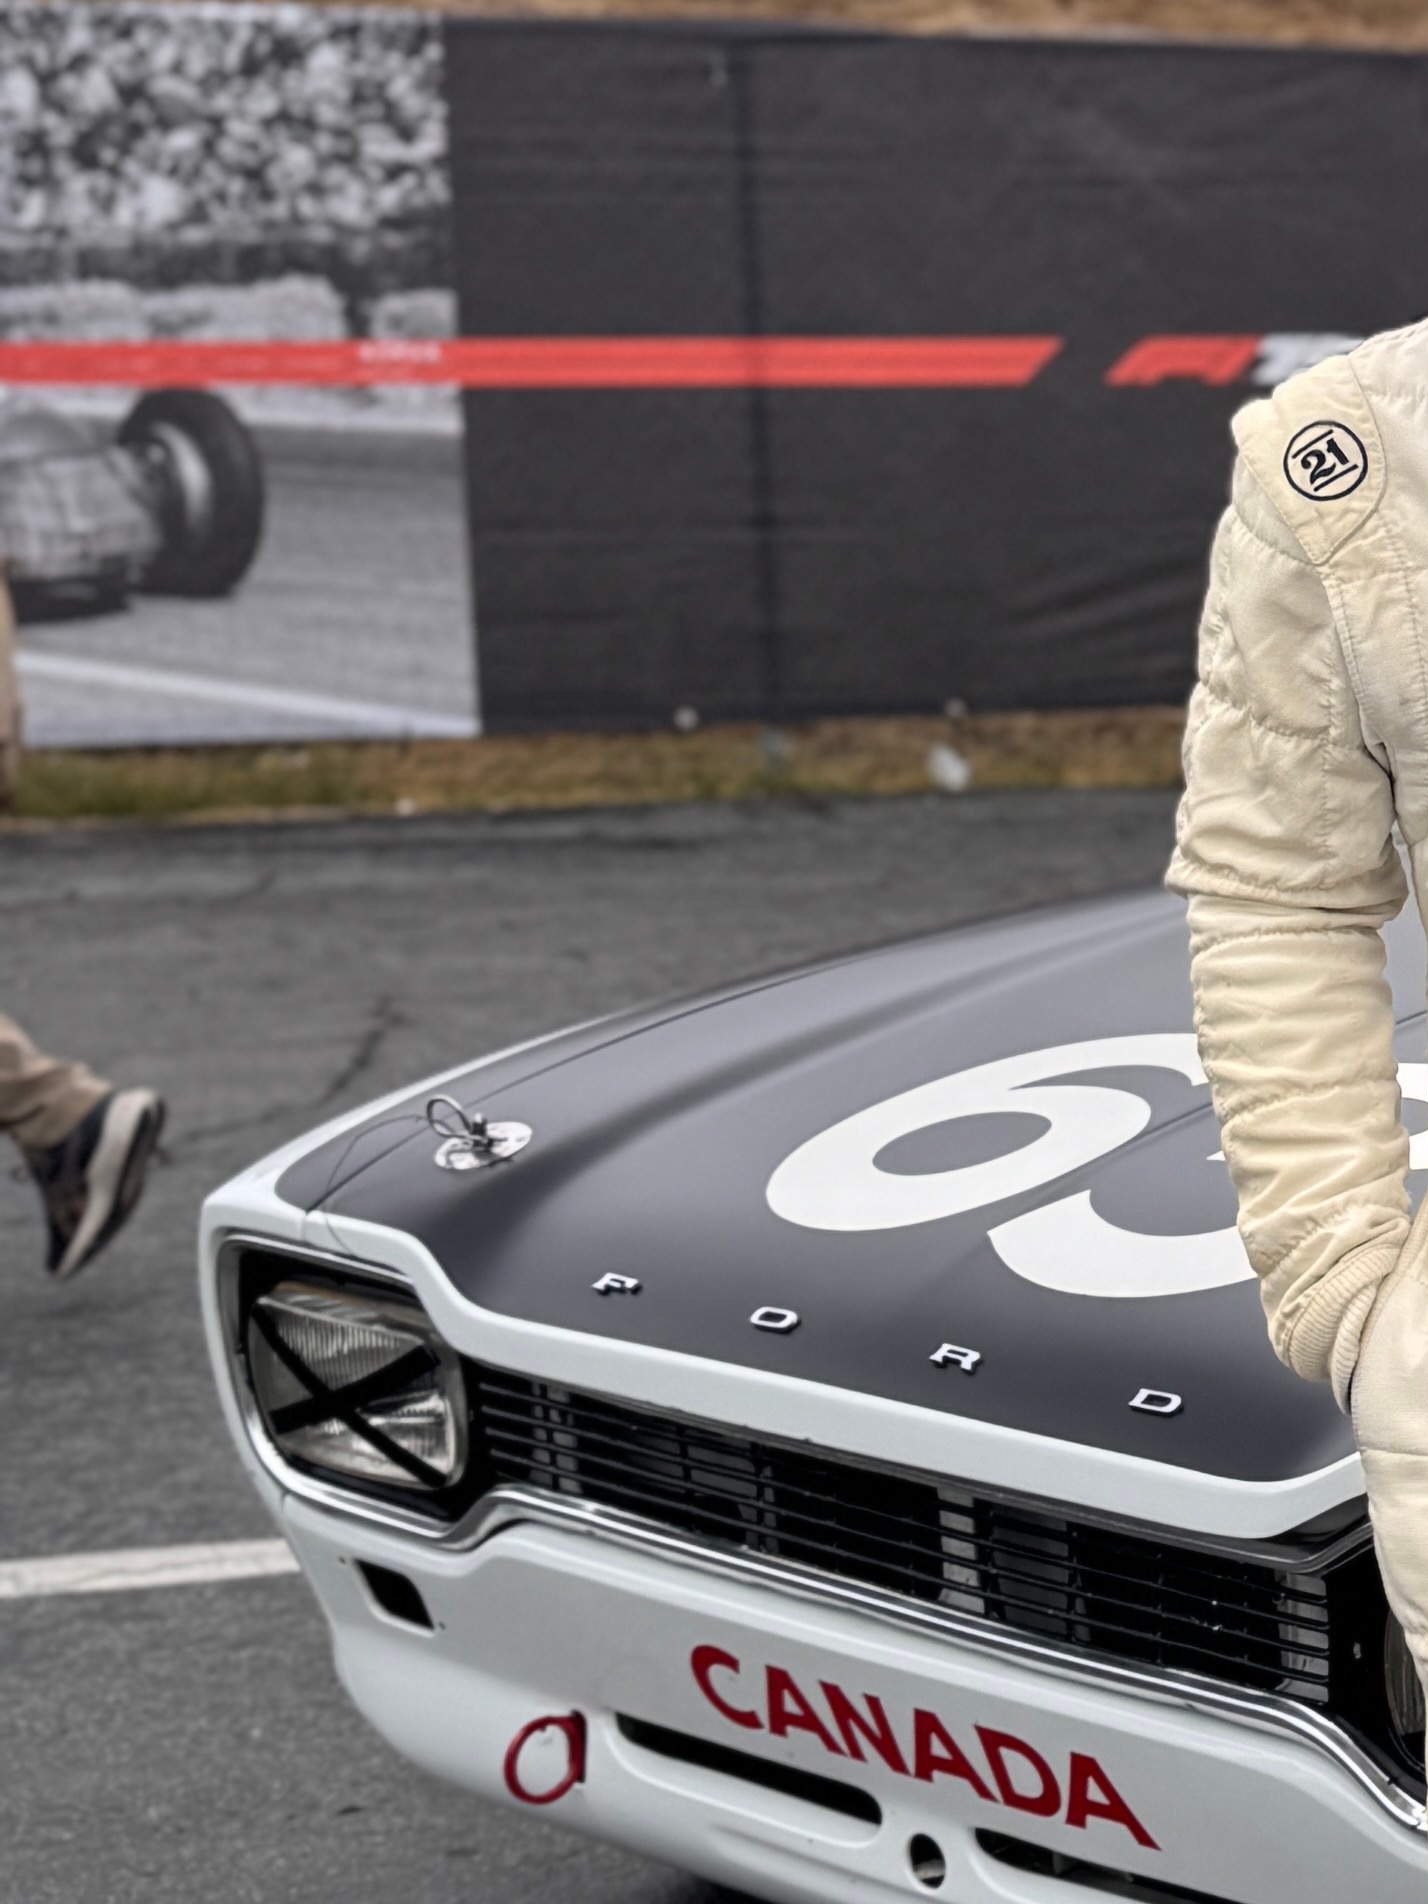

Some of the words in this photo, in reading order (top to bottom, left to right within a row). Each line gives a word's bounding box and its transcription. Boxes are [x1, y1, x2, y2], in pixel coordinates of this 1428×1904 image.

[1300, 437, 1350, 485] 21
[592, 1271, 1183, 1415] FORD
[690, 1644, 1162, 1852] CANADA
